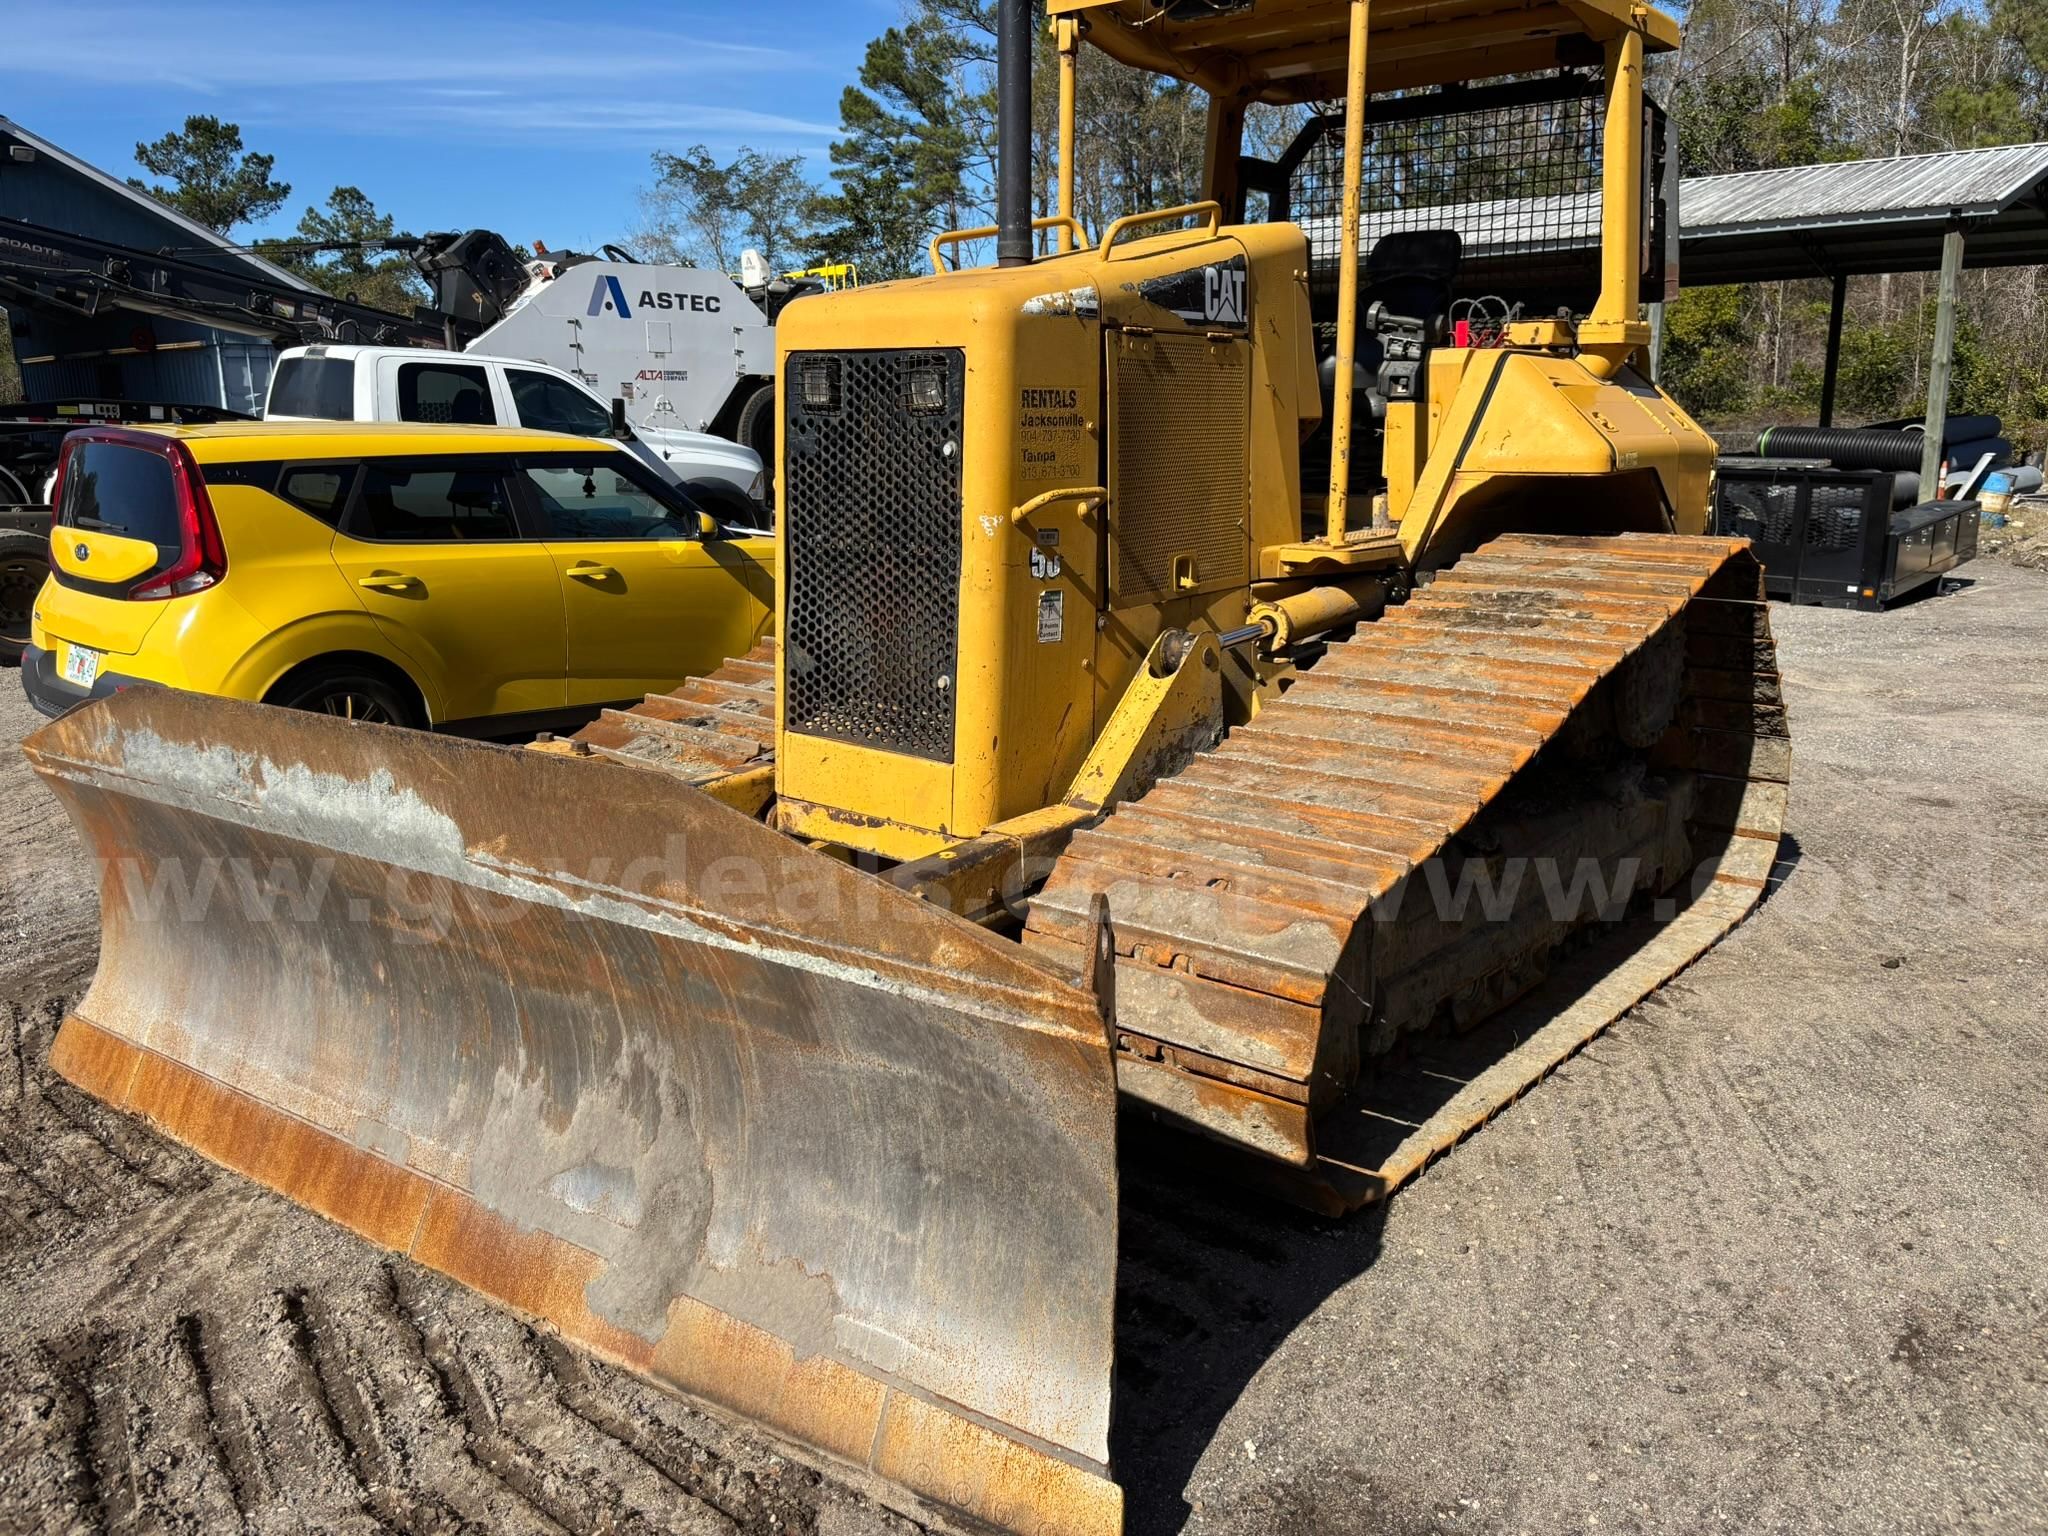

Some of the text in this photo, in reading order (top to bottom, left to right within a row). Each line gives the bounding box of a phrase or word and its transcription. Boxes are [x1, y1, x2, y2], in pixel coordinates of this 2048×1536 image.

[638, 290, 721, 313] ASTEC
[1205, 267, 1246, 322] CAT
[634, 369, 663, 381] ALTA
[1021, 389, 1077, 408] RENTALS
[1021, 414, 1084, 427] Jacksonville
[1021, 449, 1056, 464] Tampa
